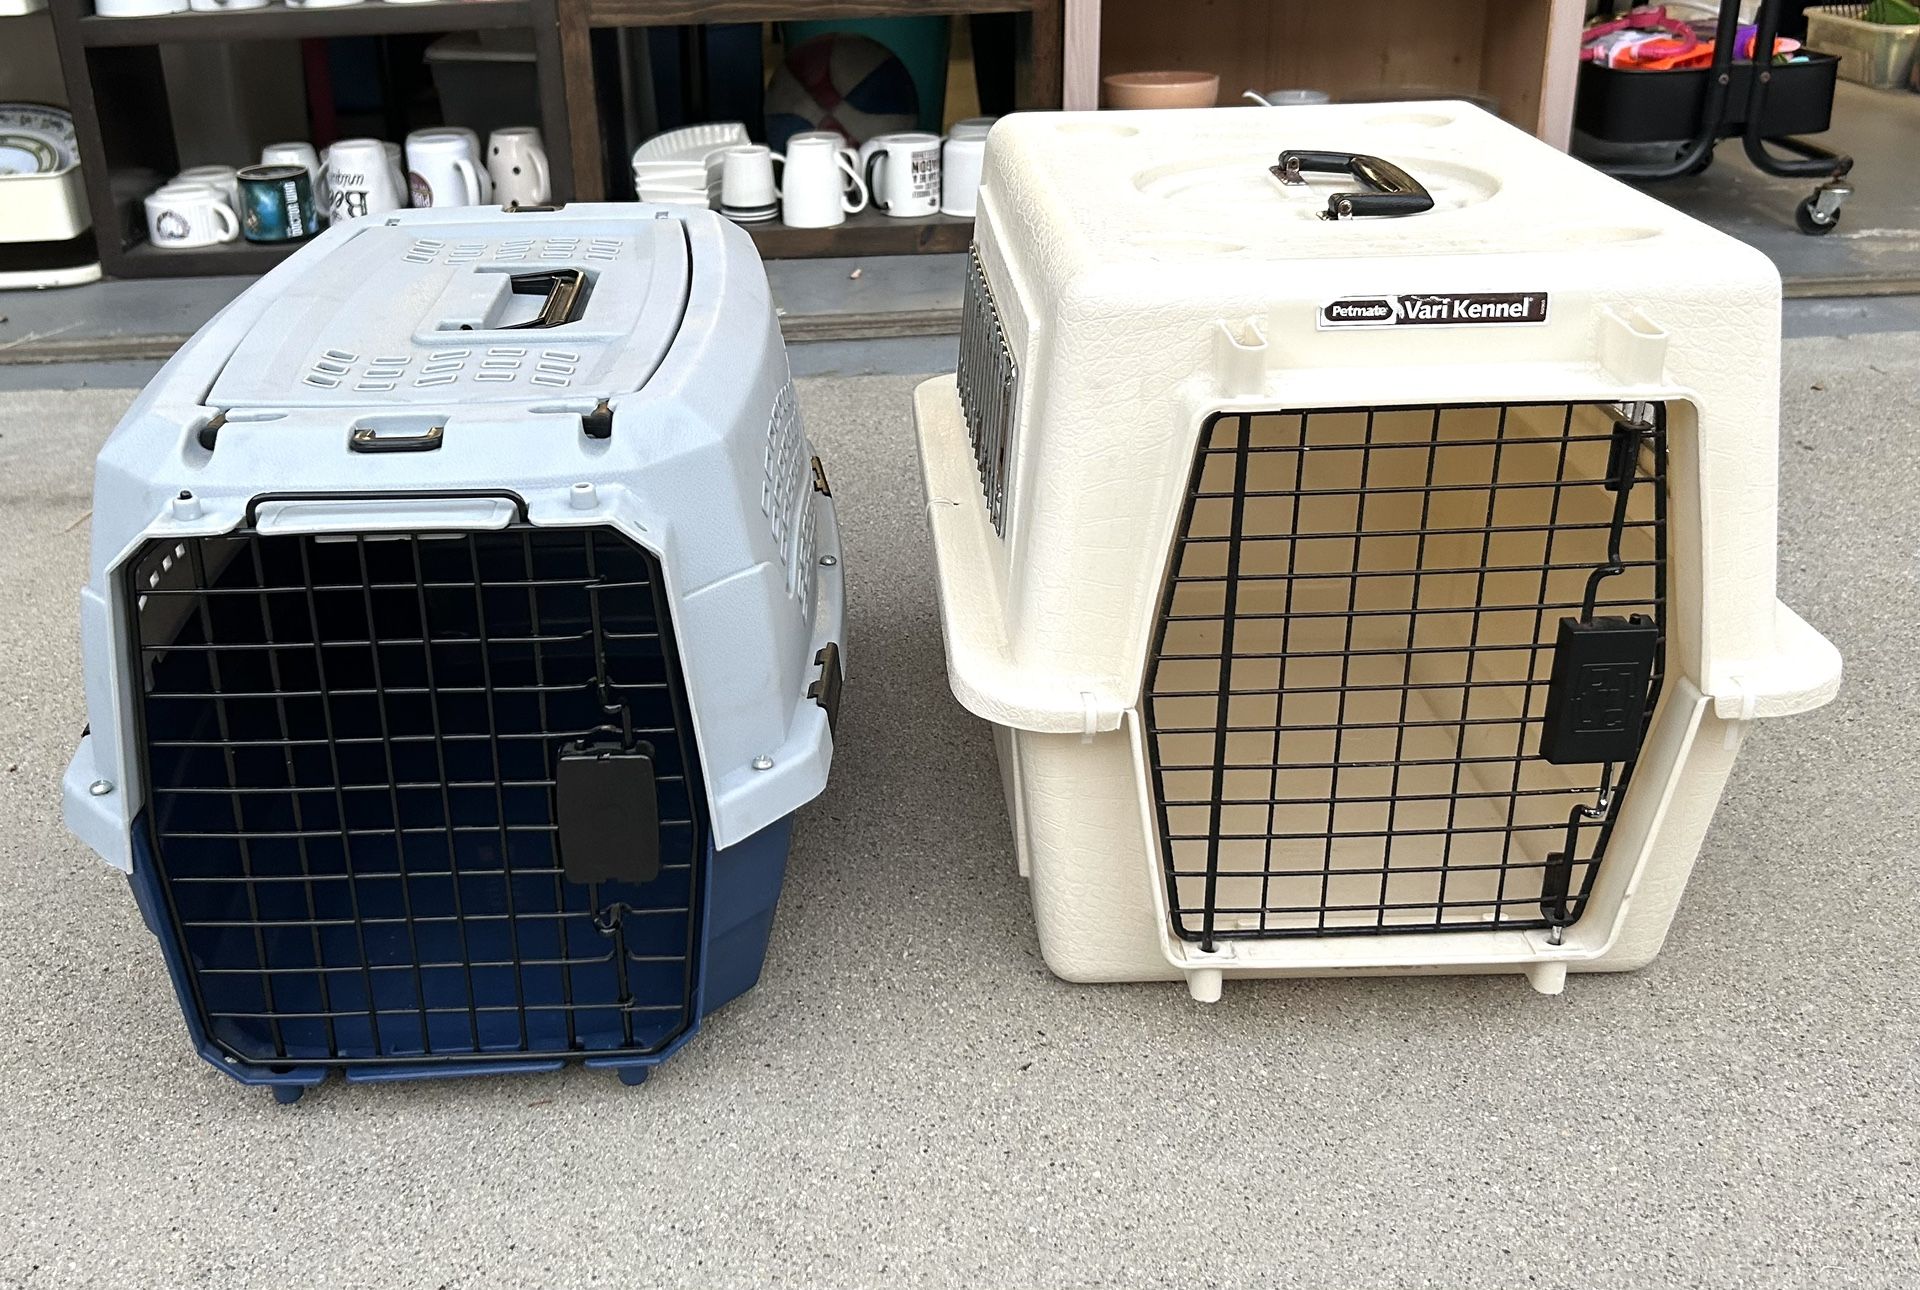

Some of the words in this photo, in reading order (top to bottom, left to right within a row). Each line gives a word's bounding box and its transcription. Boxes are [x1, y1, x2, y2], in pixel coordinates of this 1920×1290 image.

[1331, 304, 1388, 318] Petmate
[1404, 298, 1448, 319] Vari
[1452, 297, 1530, 318] Kennel
